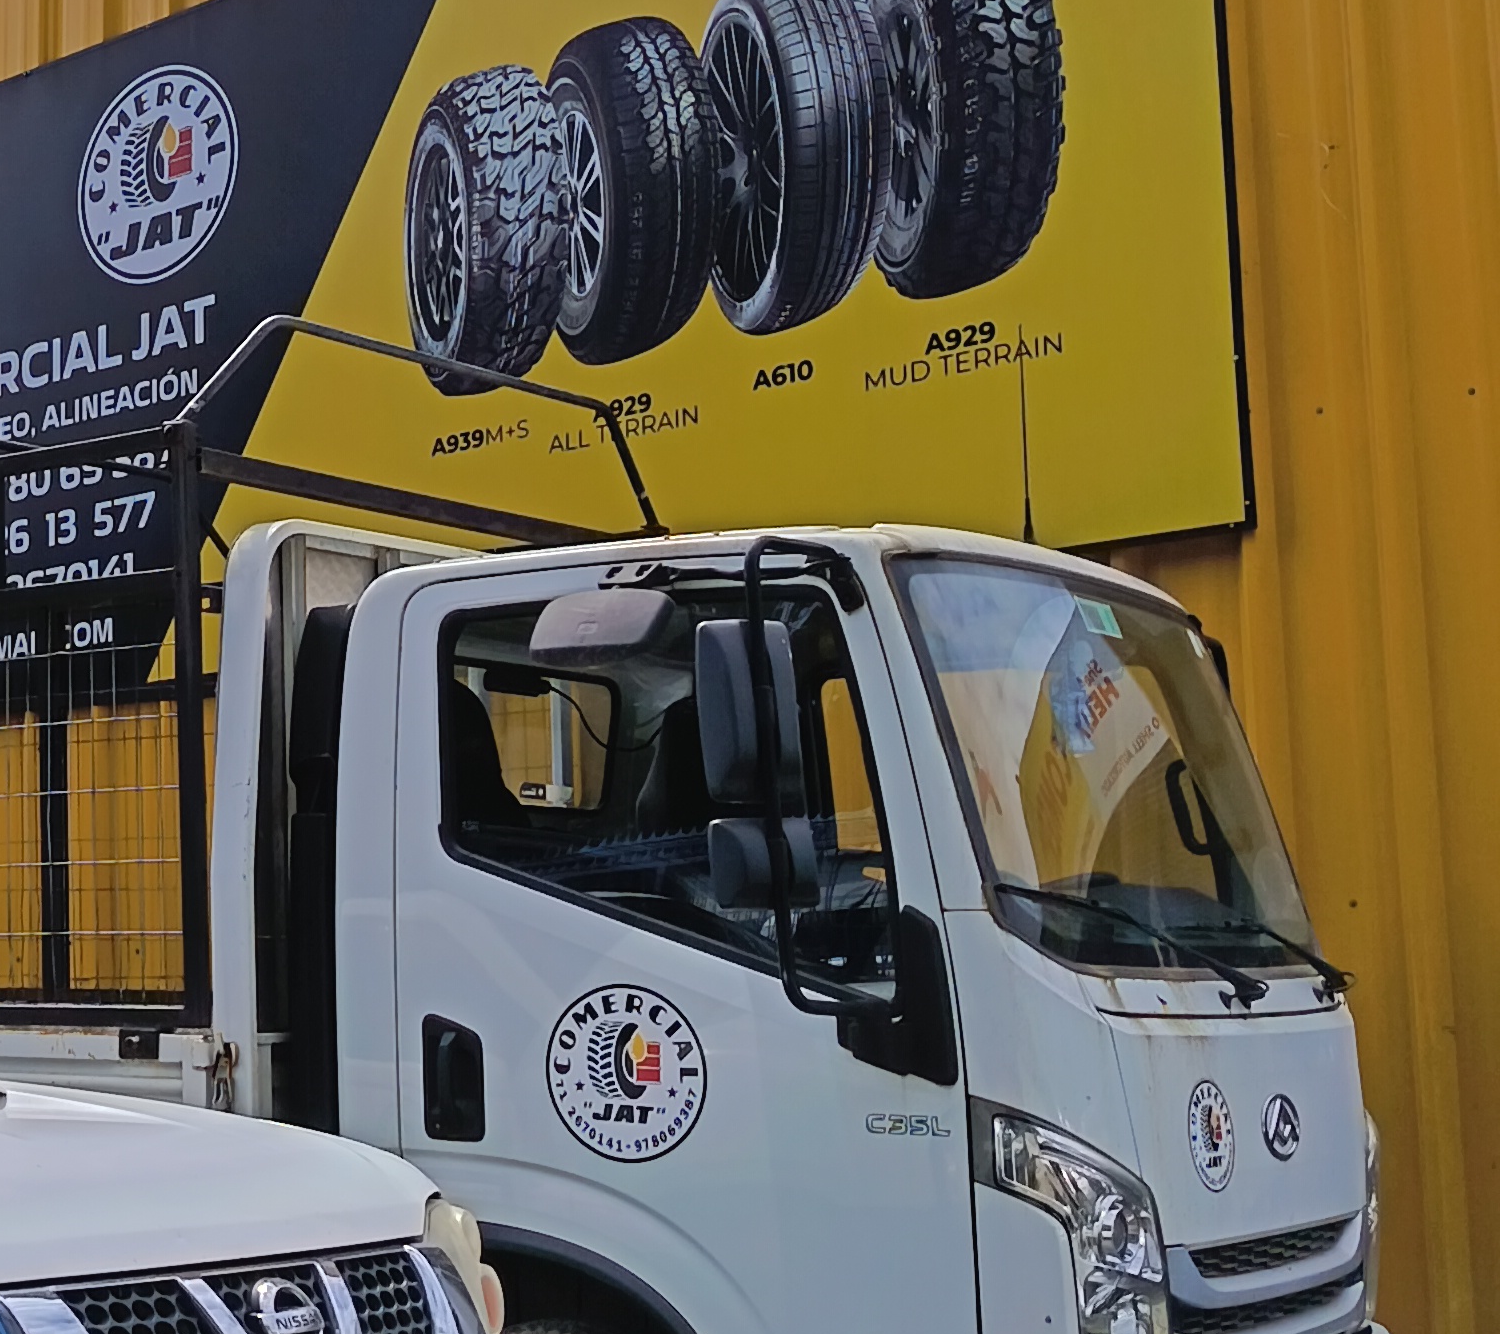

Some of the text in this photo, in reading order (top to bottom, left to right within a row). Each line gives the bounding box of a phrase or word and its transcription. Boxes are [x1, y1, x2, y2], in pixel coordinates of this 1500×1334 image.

[89, 81, 226, 202] COMERCIAL
[132, 294, 216, 361] JAT
[925, 321, 996, 355] A929
[752, 359, 814, 391] A610
[864, 332, 1063, 392] MUD TERRAIN
[43, 368, 198, 431] ALINEACIÓN
[549, 405, 699, 454] ALL TRRAIN
[4, 468, 50, 501] 80
[46, 509, 77, 547] 13
[94, 491, 156, 537] 577
[554, 993, 698, 1084] COMERCIAL
[866, 1113, 951, 1137] C35L
[275, 1312, 319, 1330] NISSA
